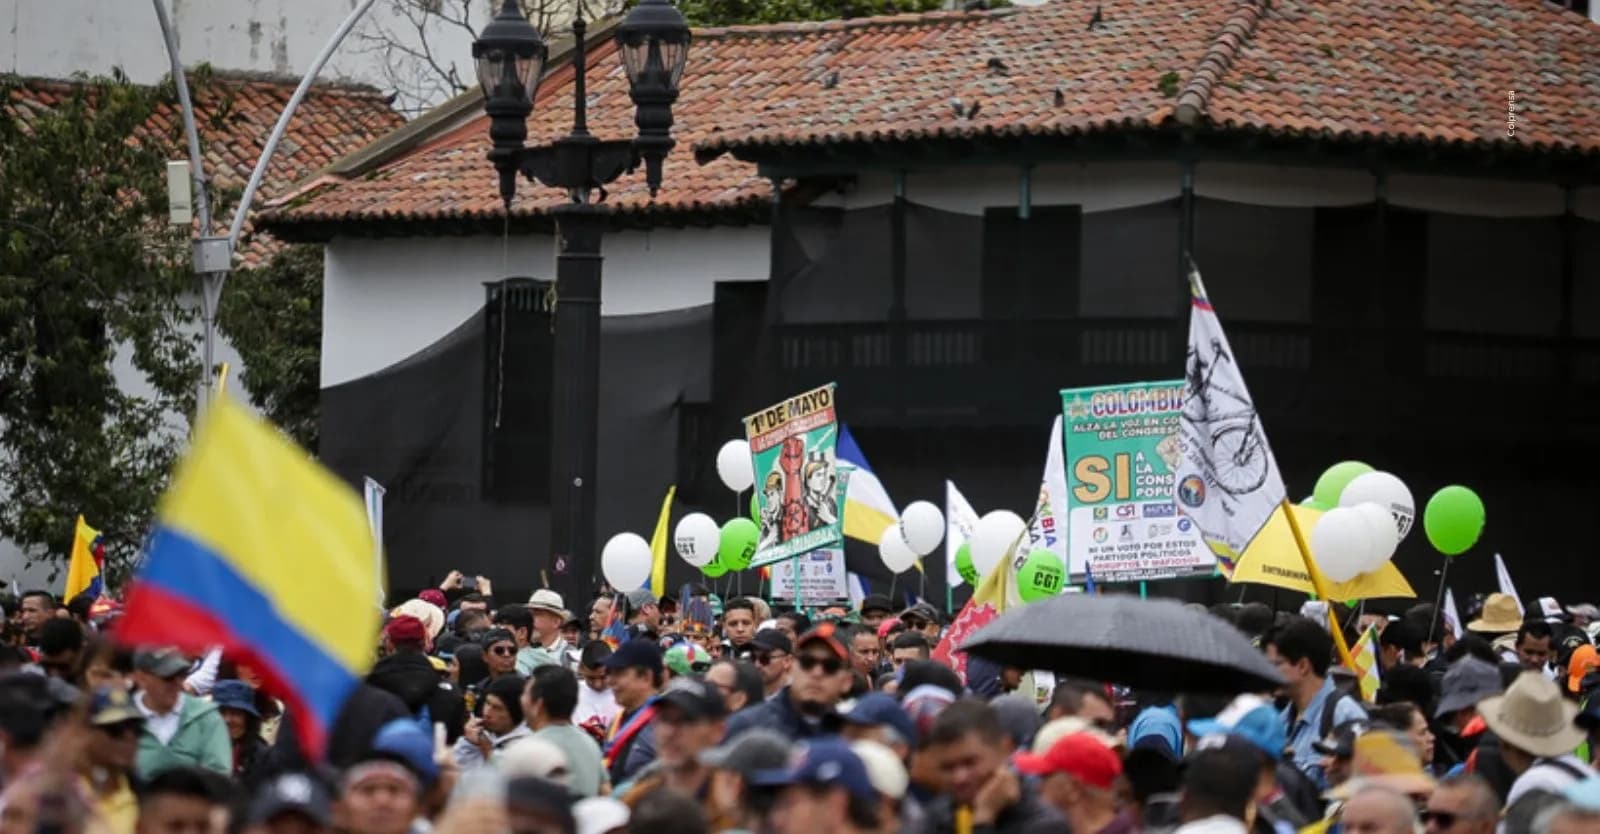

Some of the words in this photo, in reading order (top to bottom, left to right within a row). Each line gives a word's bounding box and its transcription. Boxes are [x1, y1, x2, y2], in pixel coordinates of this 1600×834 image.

[766, 404, 786, 429] DE
[788, 388, 830, 419] MAYO
[1073, 422, 1100, 433] ALZA
[1104, 421, 1118, 430] LA
[1121, 418, 1141, 429] VOZ
[1144, 416, 1159, 426] EN
[1098, 430, 1118, 440] DEL
[1136, 452, 1145, 462] A
[1136, 463, 1153, 474] LA
[1073, 452, 1131, 504] SI
[1136, 474, 1174, 486] CONS
[1136, 486, 1174, 497] POPU
[1117, 543, 1141, 552] VOTO
[1143, 541, 1162, 550] POR
[1165, 539, 1197, 548] ESTOS
[1093, 552, 1139, 561] PARTIDOS
[1033, 570, 1060, 591] CGT
